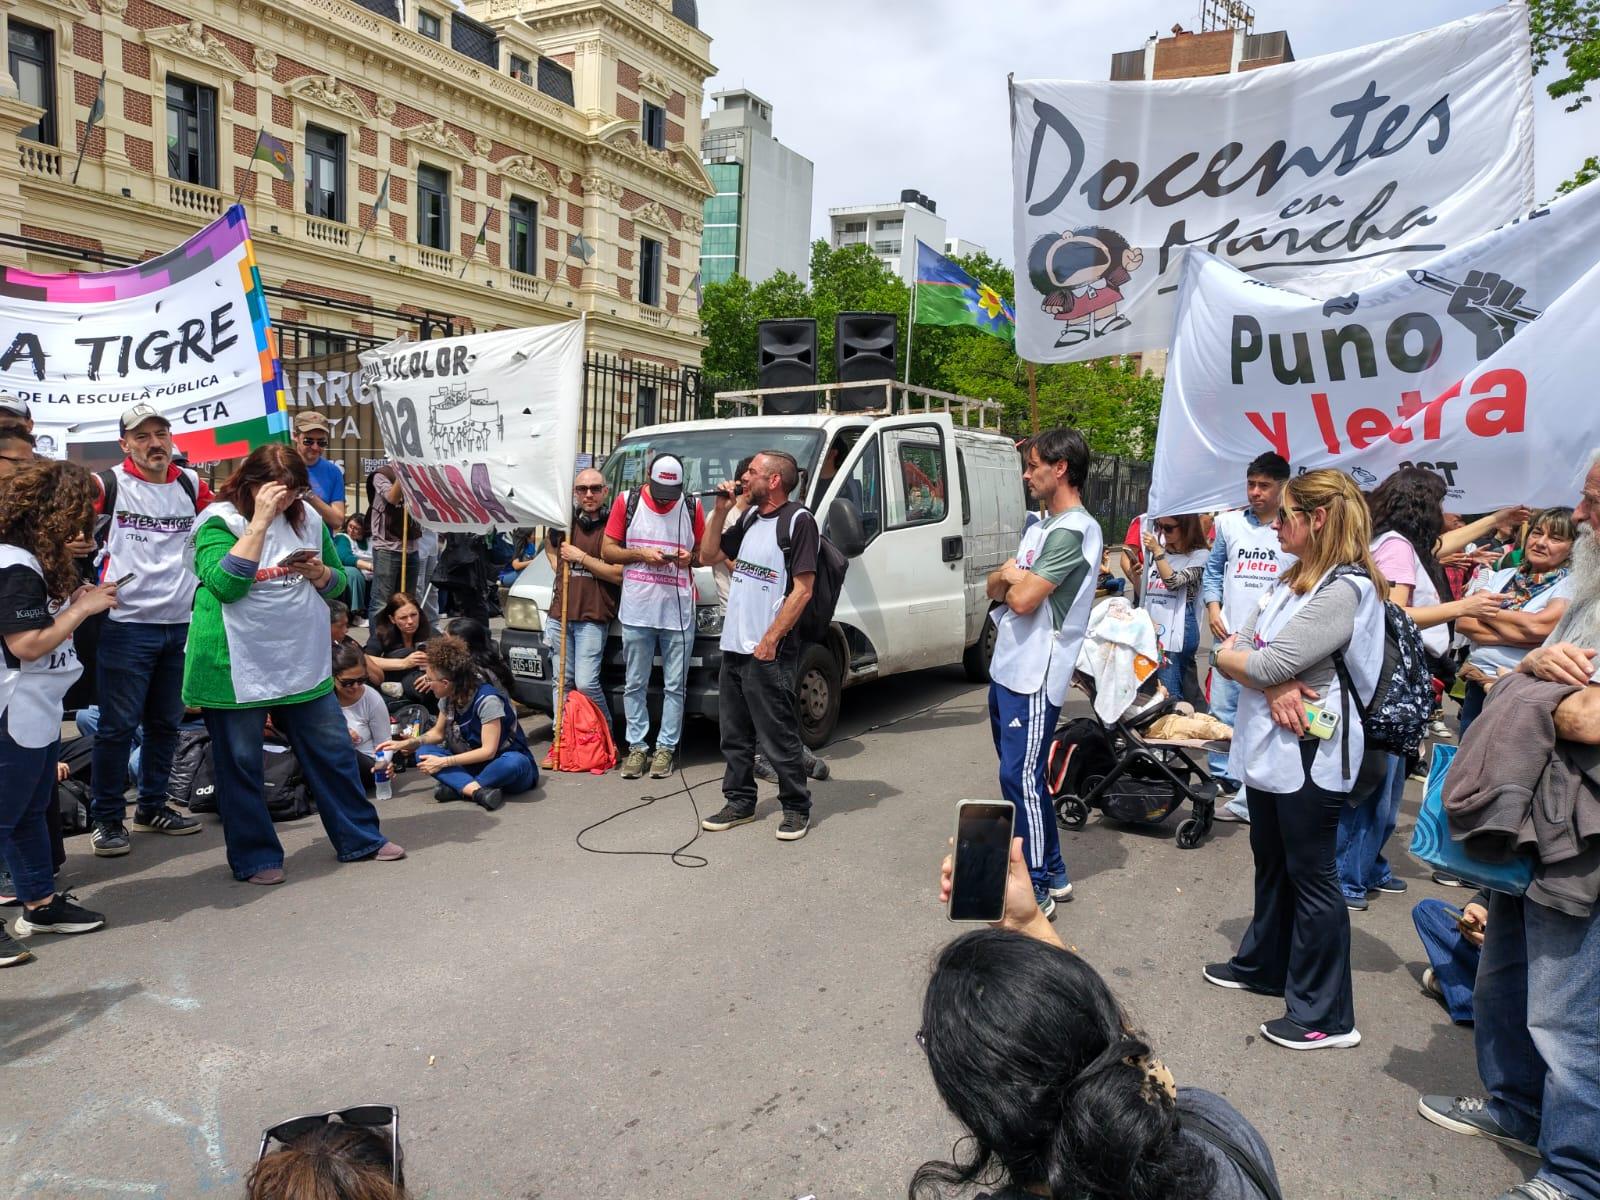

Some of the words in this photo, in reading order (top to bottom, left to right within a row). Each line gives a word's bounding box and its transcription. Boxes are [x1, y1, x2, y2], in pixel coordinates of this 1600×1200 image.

[1026, 80, 1451, 216] Docentes
[1279, 191, 1346, 220] en
[1158, 180, 1438, 276] Marcha
[74, 301, 239, 382] TIGRE
[1231, 291, 1443, 385] Puño
[18, 391, 42, 404] DE
[48, 394, 71, 404] LA
[76, 391, 151, 405] ESCUELA
[156, 374, 220, 398] PÚBLICA
[183, 401, 229, 425] CTA
[1245, 412, 1291, 463] y
[1311, 368, 1528, 457] letra
[1236, 562, 1244, 573] y
[1247, 560, 1277, 573] letra
[1238, 548, 1267, 560] Puño
[196, 784, 214, 796] adi
